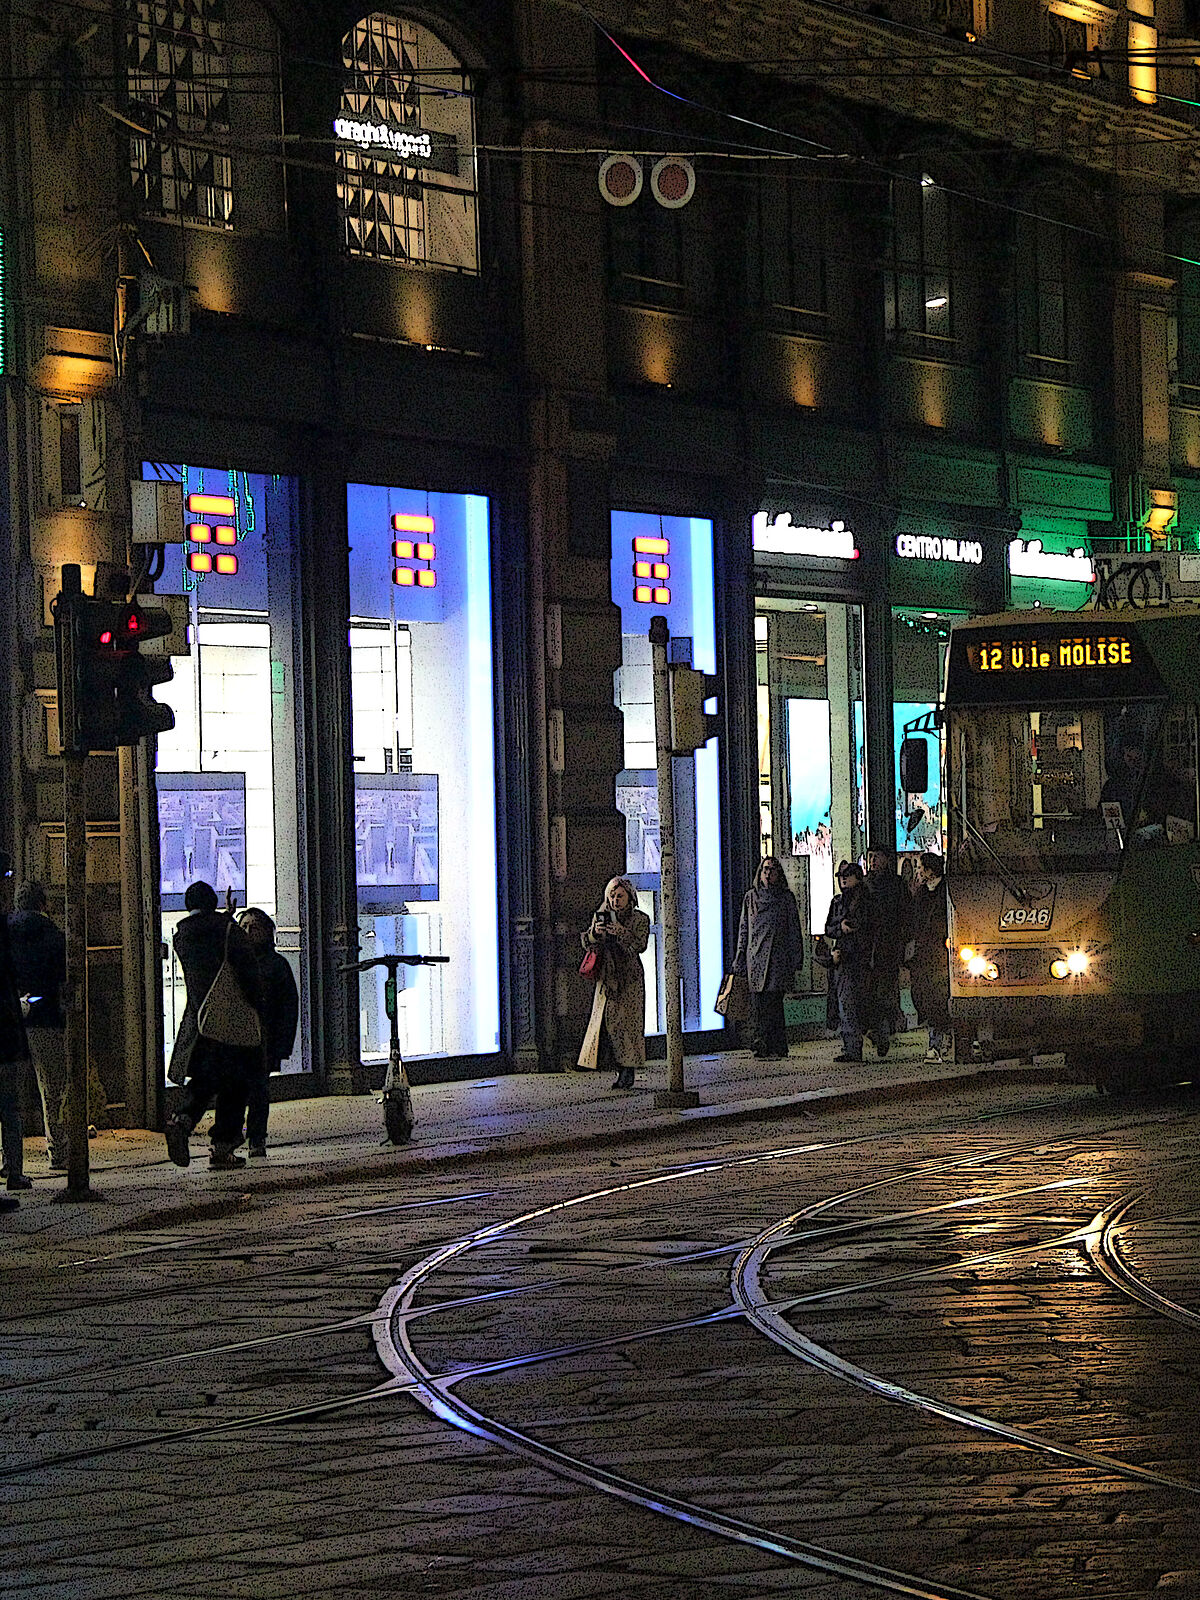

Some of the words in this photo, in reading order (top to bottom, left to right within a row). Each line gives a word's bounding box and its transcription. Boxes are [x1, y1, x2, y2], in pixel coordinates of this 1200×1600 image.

[897, 534, 940, 561] CENTRO
[941, 537, 983, 565] MILANO
[979, 648, 1003, 671] 12
[1011, 645, 1051, 669] V.le
[1059, 642, 1132, 666] MOLISE
[1002, 907, 1050, 926] 4946
